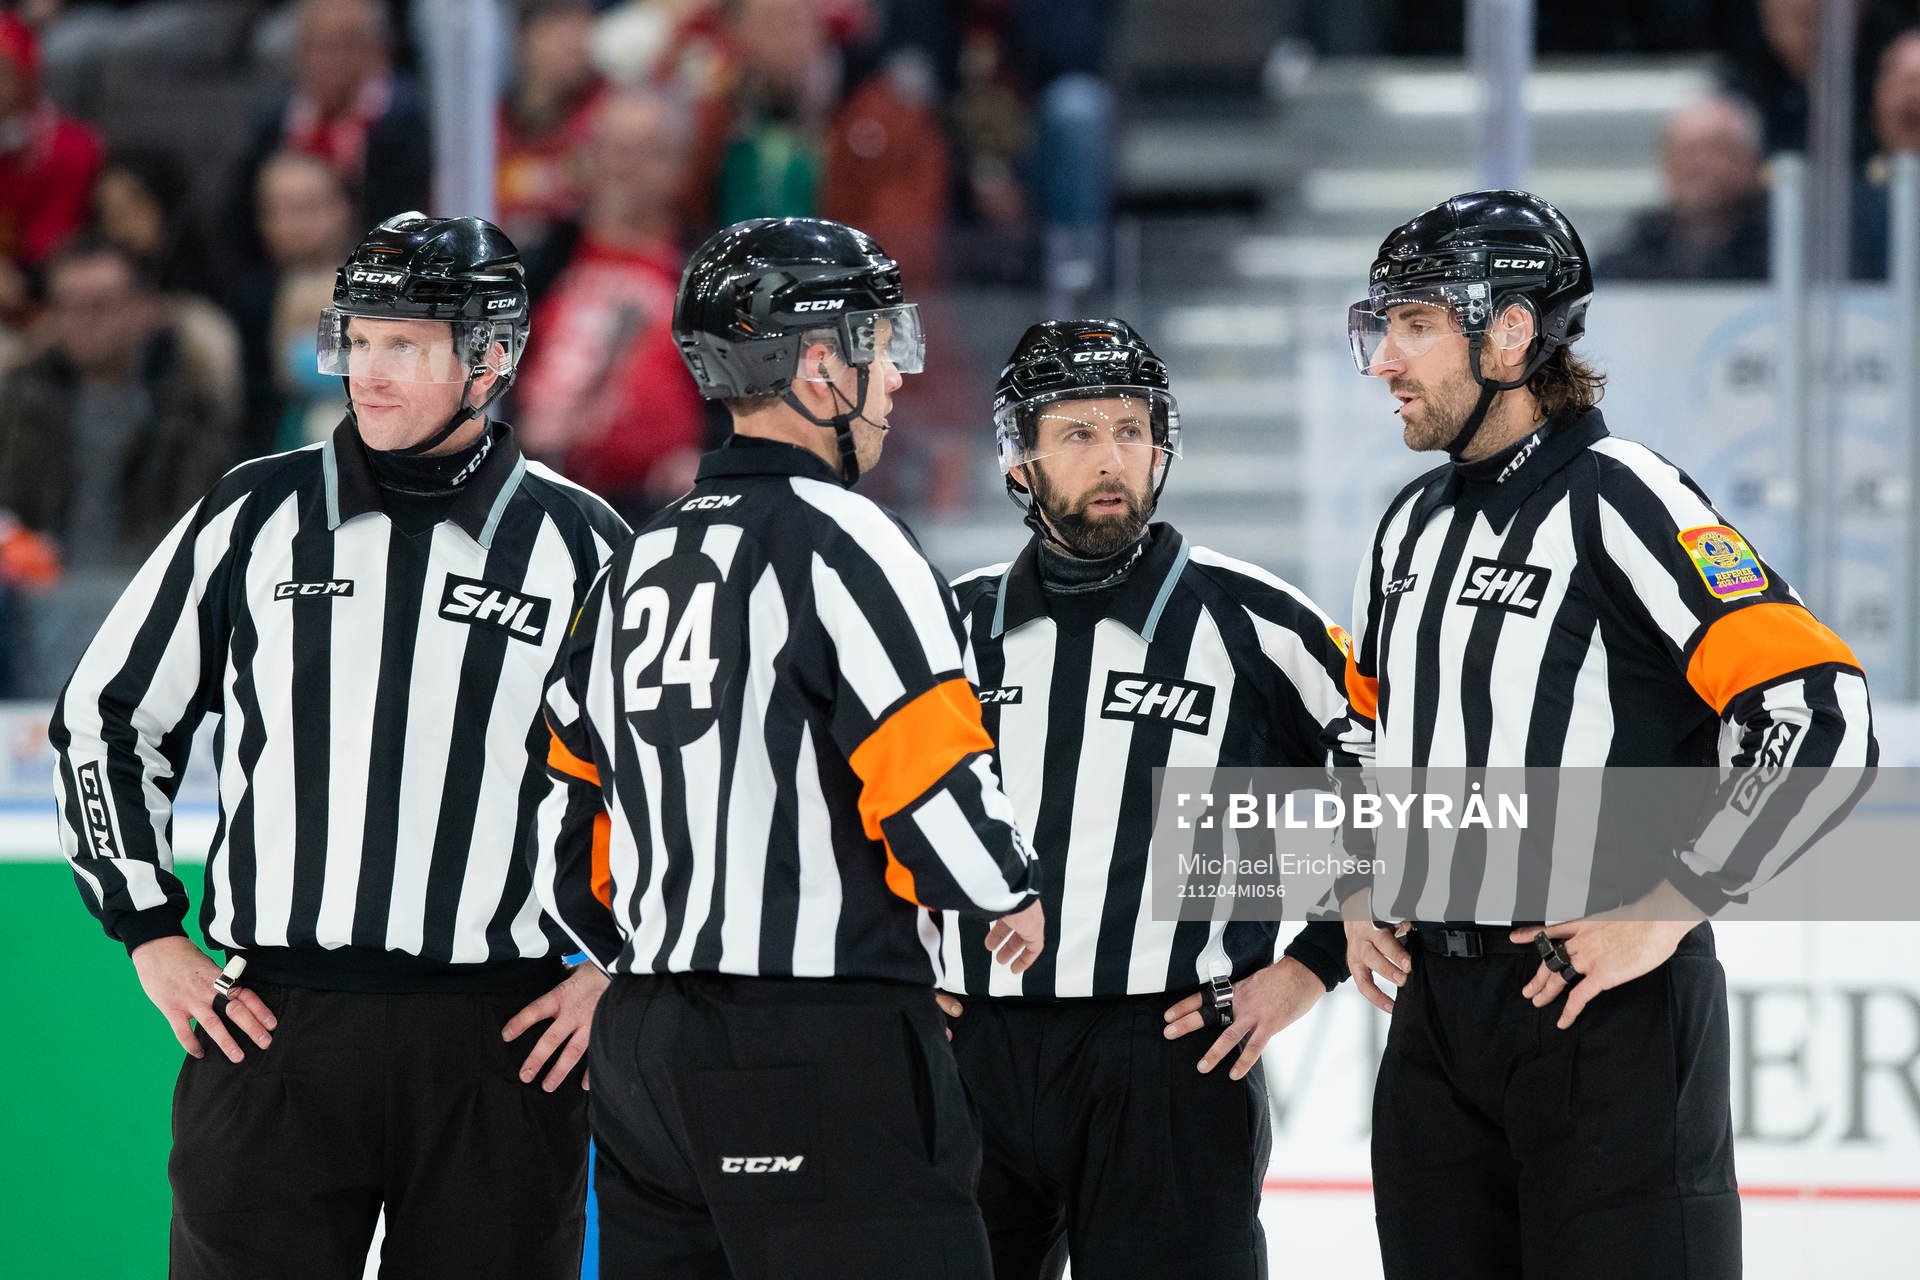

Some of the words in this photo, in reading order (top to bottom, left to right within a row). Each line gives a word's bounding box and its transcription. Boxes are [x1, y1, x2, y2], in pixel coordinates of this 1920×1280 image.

[1493, 258, 1546, 270] CCM
[352, 271, 402, 285] CCM
[487, 297, 516, 310] CCM
[794, 299, 844, 313] CCM
[1073, 351, 1129, 363] CCM
[451, 435, 492, 486] CCM
[681, 494, 742, 512] CCM
[1714, 567, 1755, 582] REFEREE
[275, 580, 352, 598] CCM
[1461, 566, 1539, 609] SHL
[443, 584, 543, 638] SHL
[621, 581, 720, 713] 24
[978, 688, 1020, 704] CM
[1105, 679, 1207, 726] SHL
[1737, 722, 1792, 811] CCM
[81, 767, 115, 858] CCM
[721, 1155, 804, 1173] CCM
